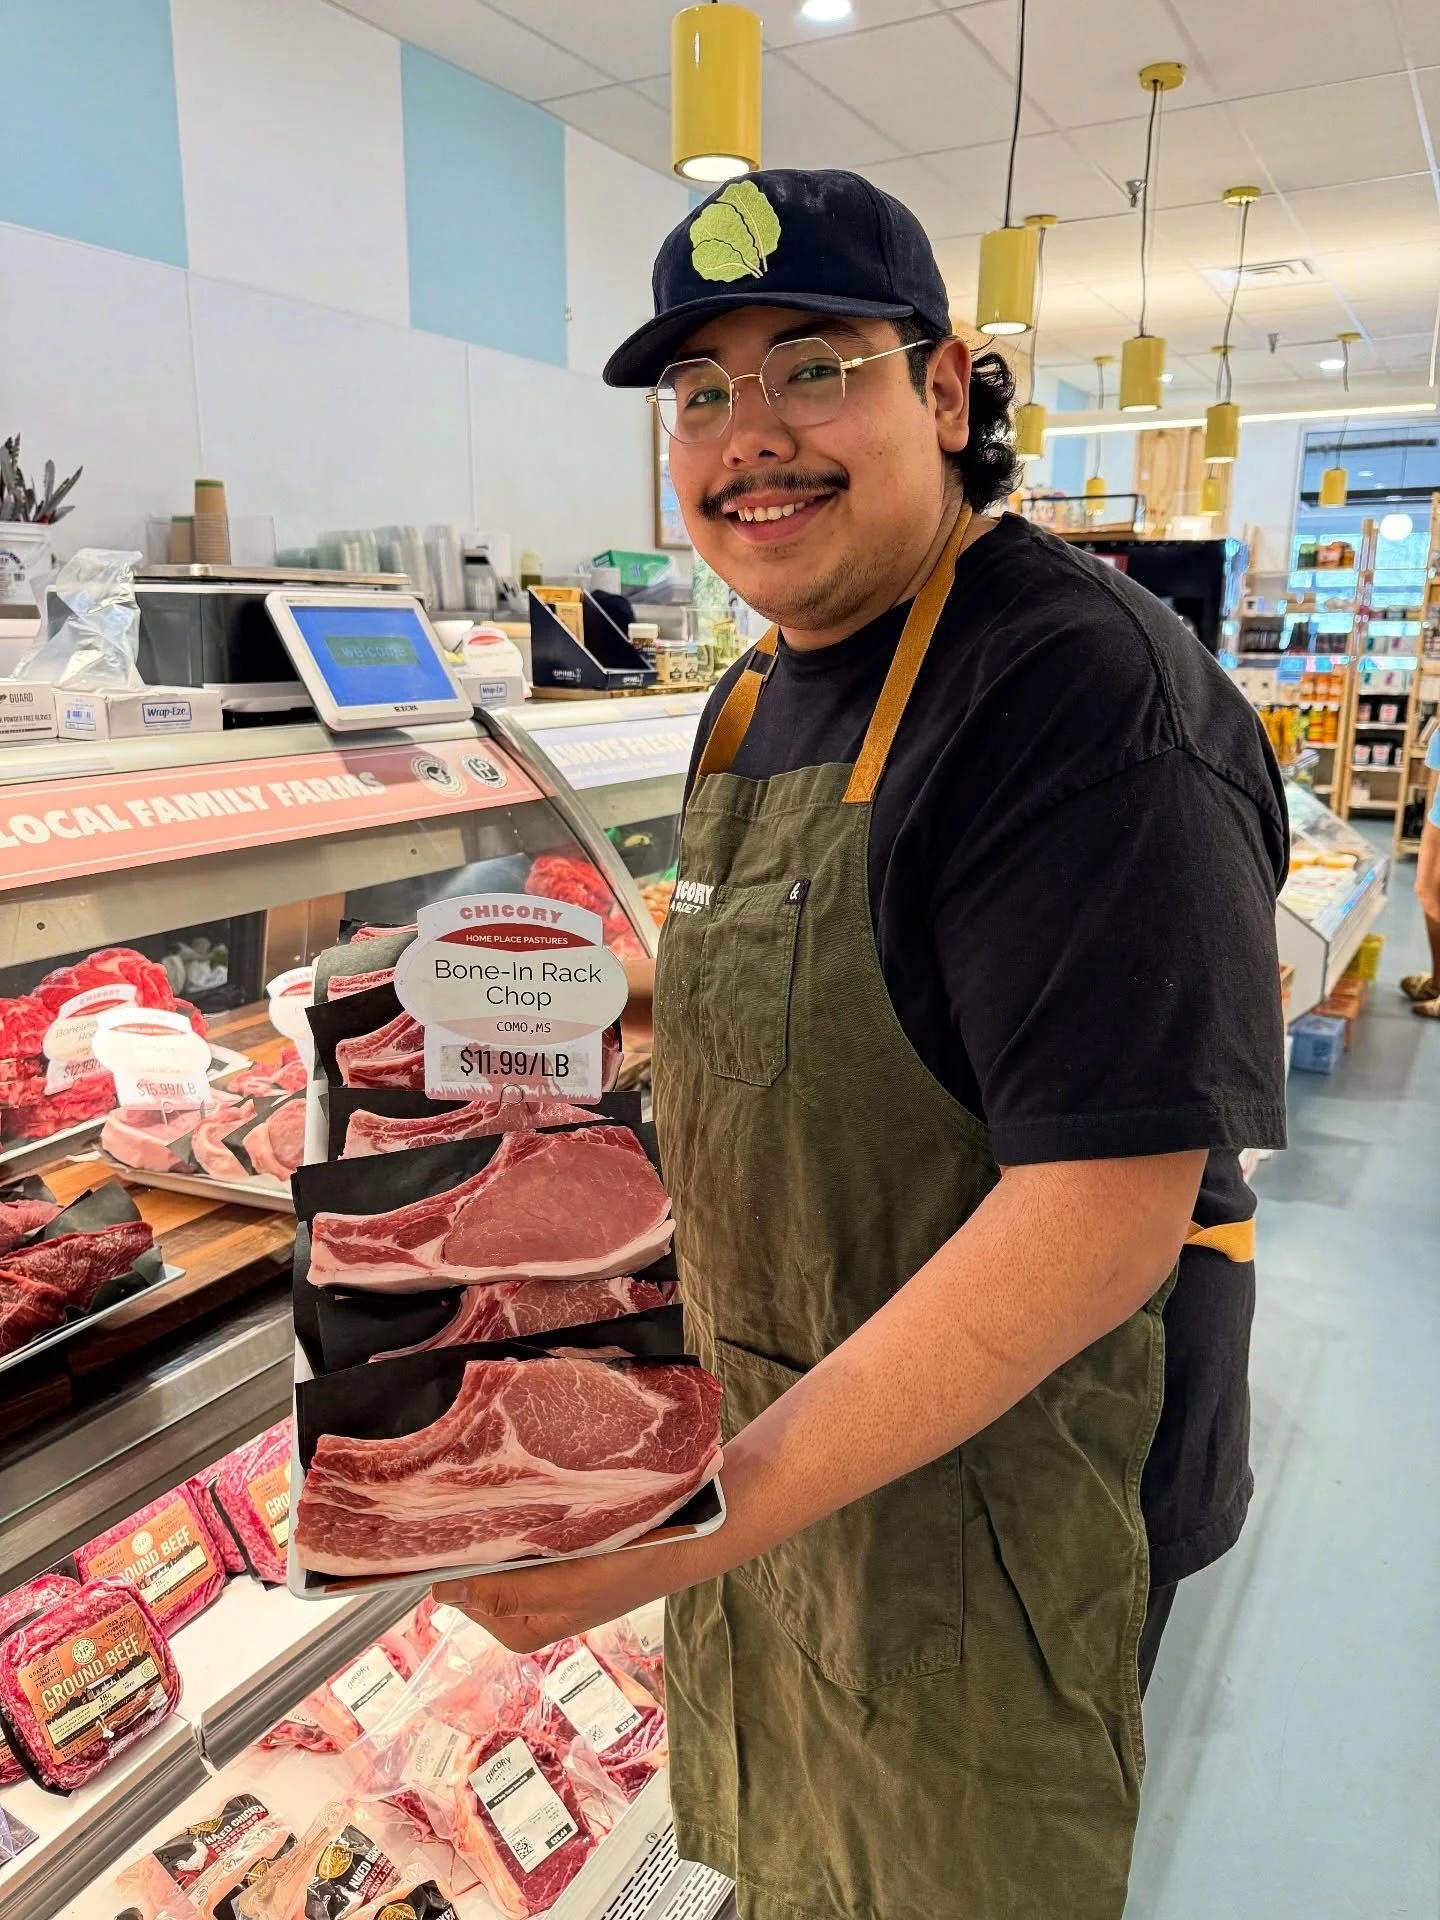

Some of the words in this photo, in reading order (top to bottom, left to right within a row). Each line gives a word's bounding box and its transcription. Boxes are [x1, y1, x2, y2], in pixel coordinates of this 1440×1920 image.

[9, 692, 34, 704] GUARD
[125, 784, 271, 829] FAMILY
[266, 771, 387, 808] FARMS
[675, 879, 715, 906] ICORY
[459, 904, 564, 924] CHICORY
[669, 900, 703, 915] ARKET
[465, 934, 493, 943] HOME
[493, 935, 522, 944] PLACE
[523, 936, 569, 945] PASTURES
[435, 959, 533, 981] Bone-In
[542, 962, 602, 983] Rack
[486, 985, 552, 1011] Chop
[460, 1047, 570, 1078] $11.99/LB
[120, 1549, 160, 1581] OUND
[160, 1523, 191, 1557] BEEF
[41, 1659, 105, 1713] GROUND
[105, 1632, 141, 1670] BEEF
[485, 1756, 513, 1784] CHICORY
[204, 1824, 233, 1845] NAKED
[230, 1804, 267, 1827] CHICKEN
[348, 1860, 372, 1890] NAKED
